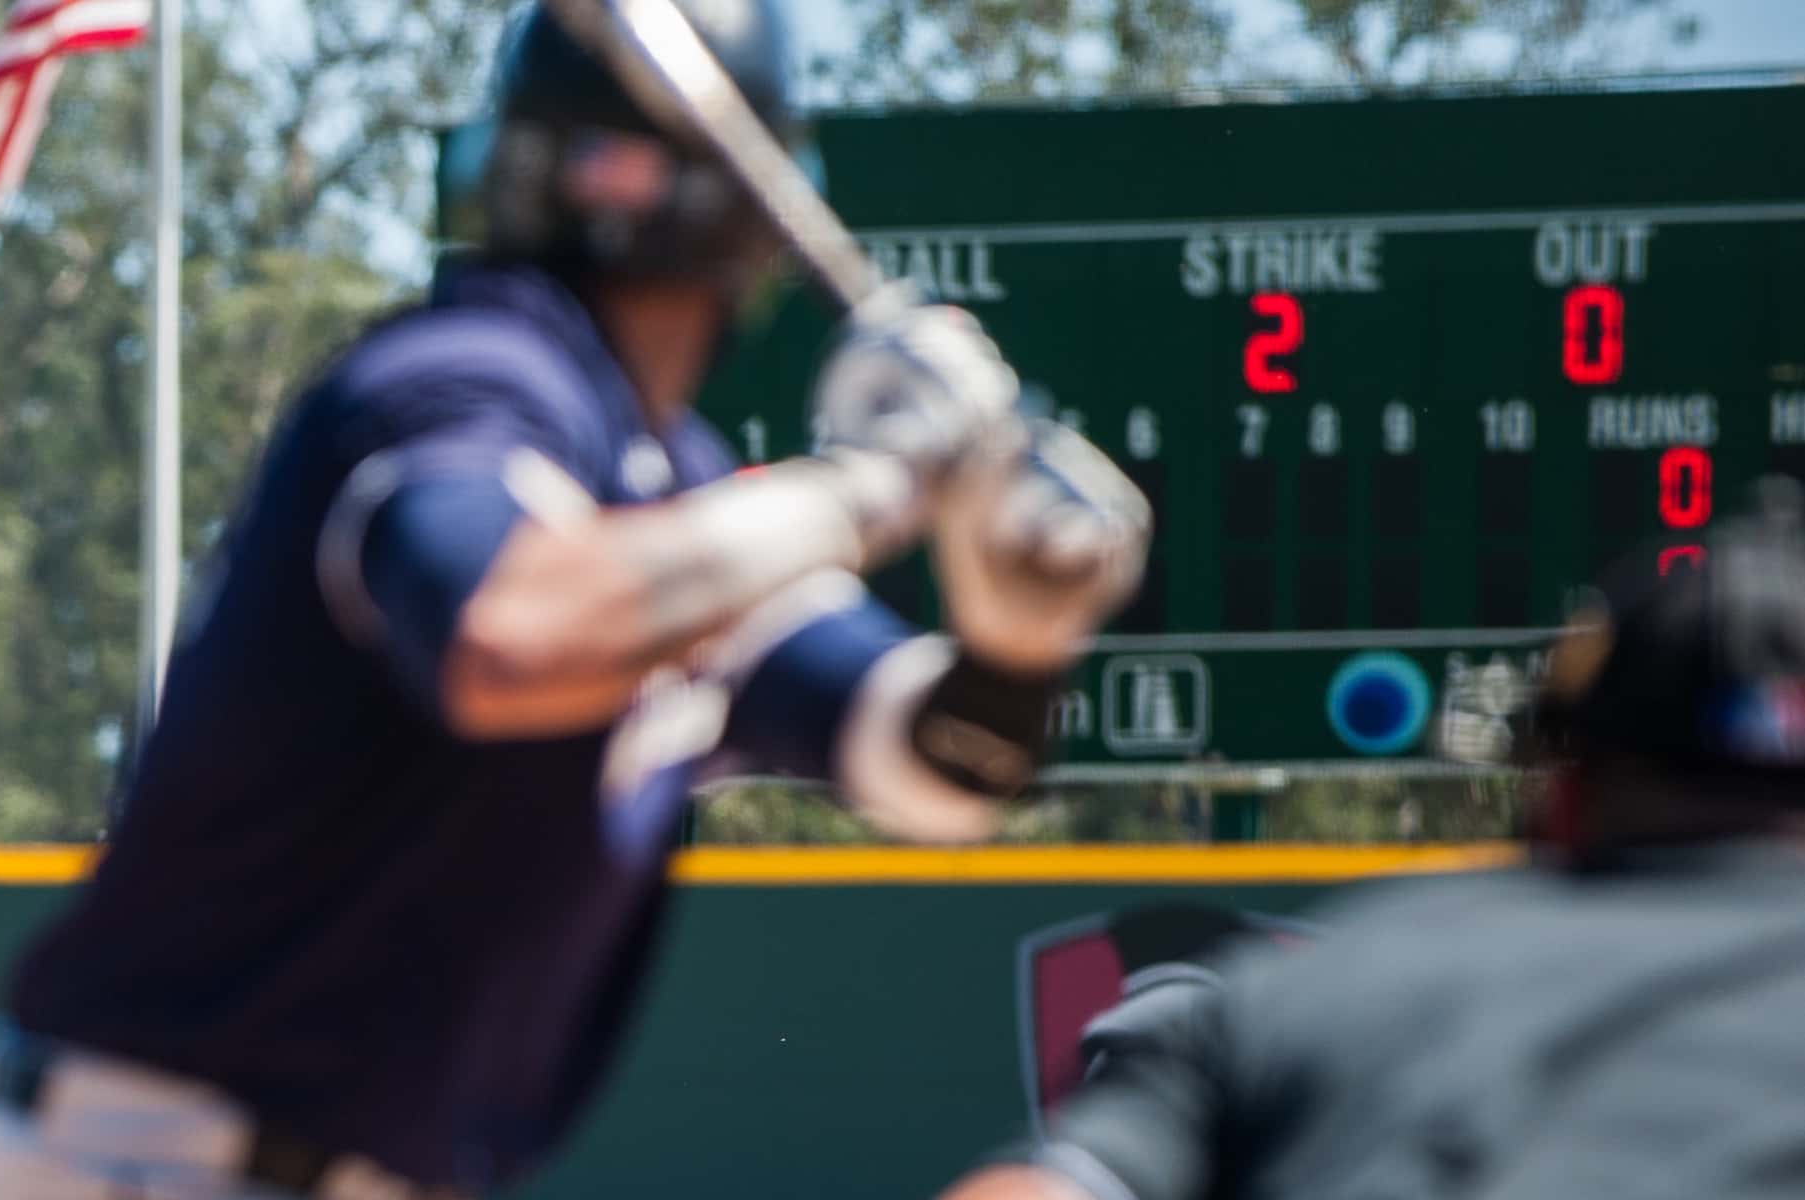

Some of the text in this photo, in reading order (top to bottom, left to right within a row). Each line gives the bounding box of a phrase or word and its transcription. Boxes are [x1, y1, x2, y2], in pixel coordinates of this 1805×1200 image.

[1181, 226, 1384, 297] STRIKE
[1534, 221, 1653, 285] OUT
[1244, 291, 1303, 392] 2
[1563, 283, 1623, 384] 0
[1237, 404, 1268, 457] 7
[1480, 398, 1535, 452] 10
[1587, 393, 1718, 449] RUNS
[1659, 444, 1712, 528] 0
